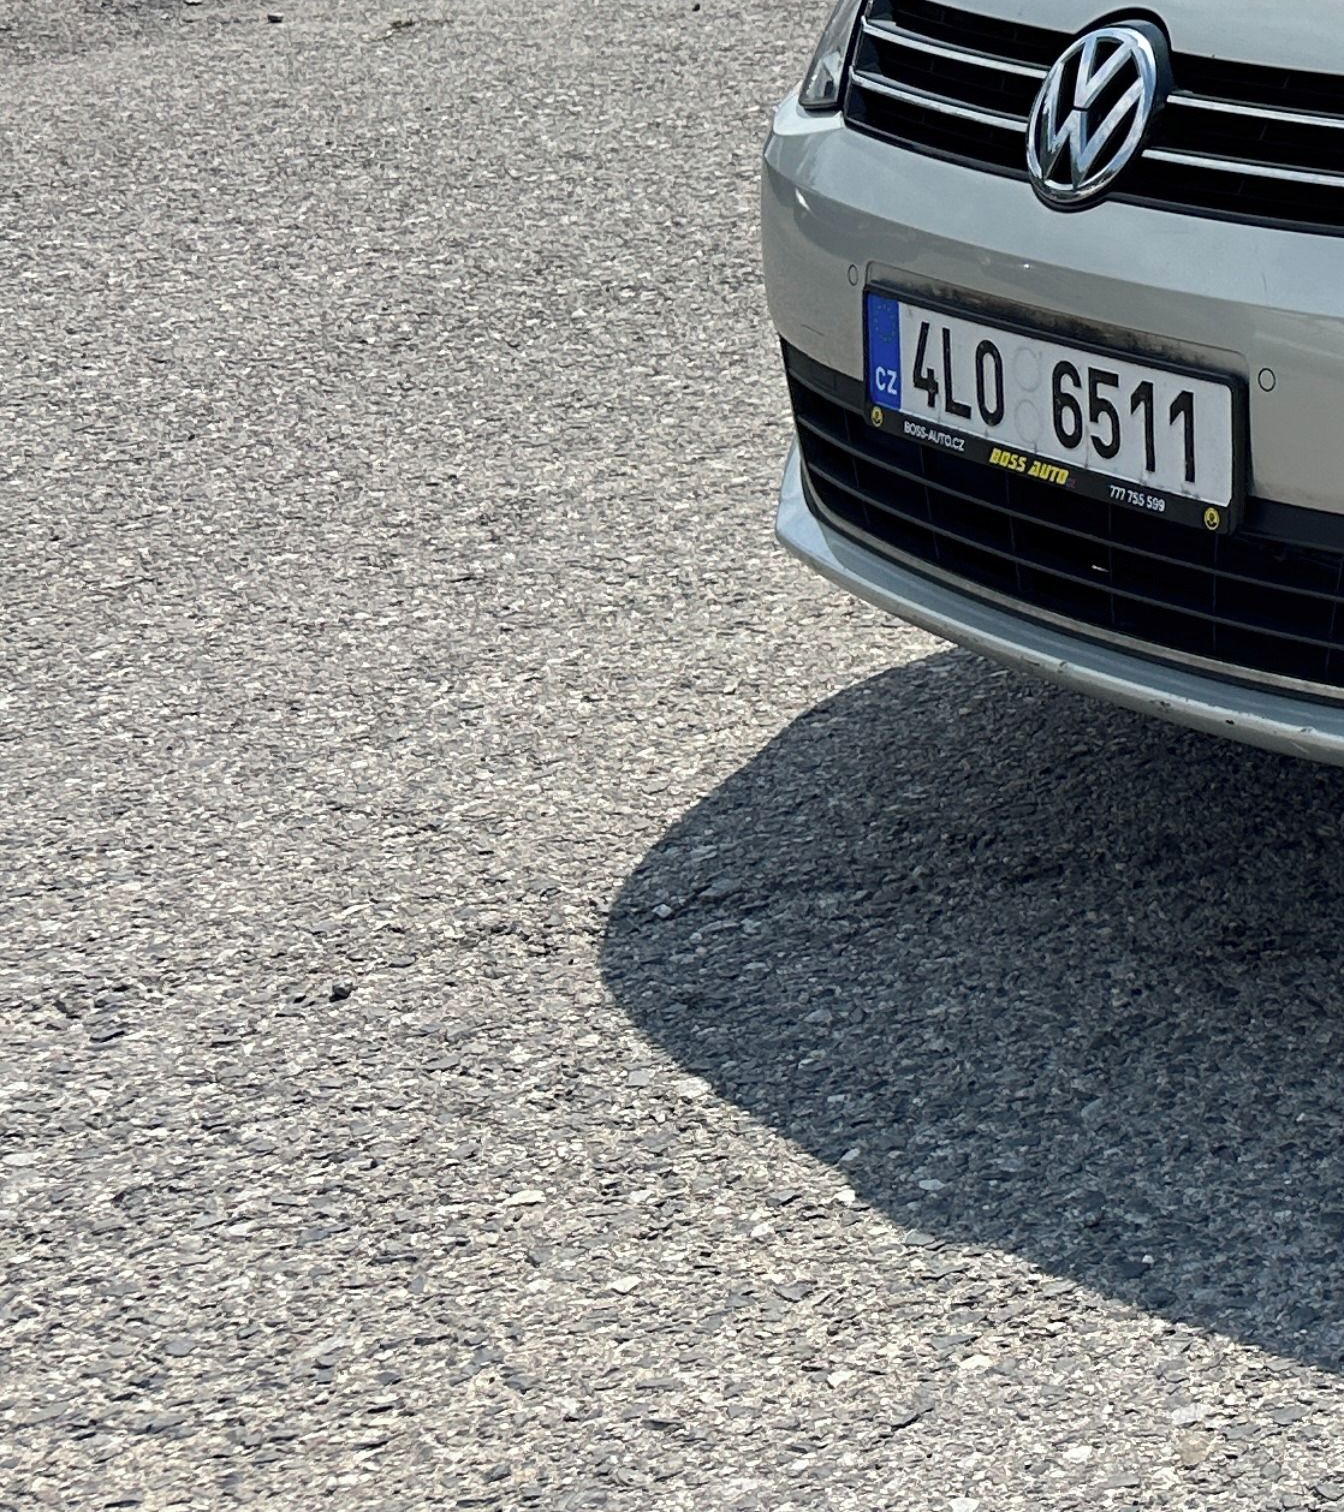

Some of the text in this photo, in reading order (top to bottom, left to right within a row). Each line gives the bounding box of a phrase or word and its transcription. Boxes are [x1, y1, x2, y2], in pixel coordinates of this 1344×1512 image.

[875, 366, 898, 395] CZ
[904, 421, 965, 452] BOSS-AUTO.CZ
[1052, 360, 1195, 483] 6511
[989, 448, 1028, 472] BOSS
[1027, 461, 1070, 485] AUTO
[1110, 485, 1165, 512] 777 755 599
